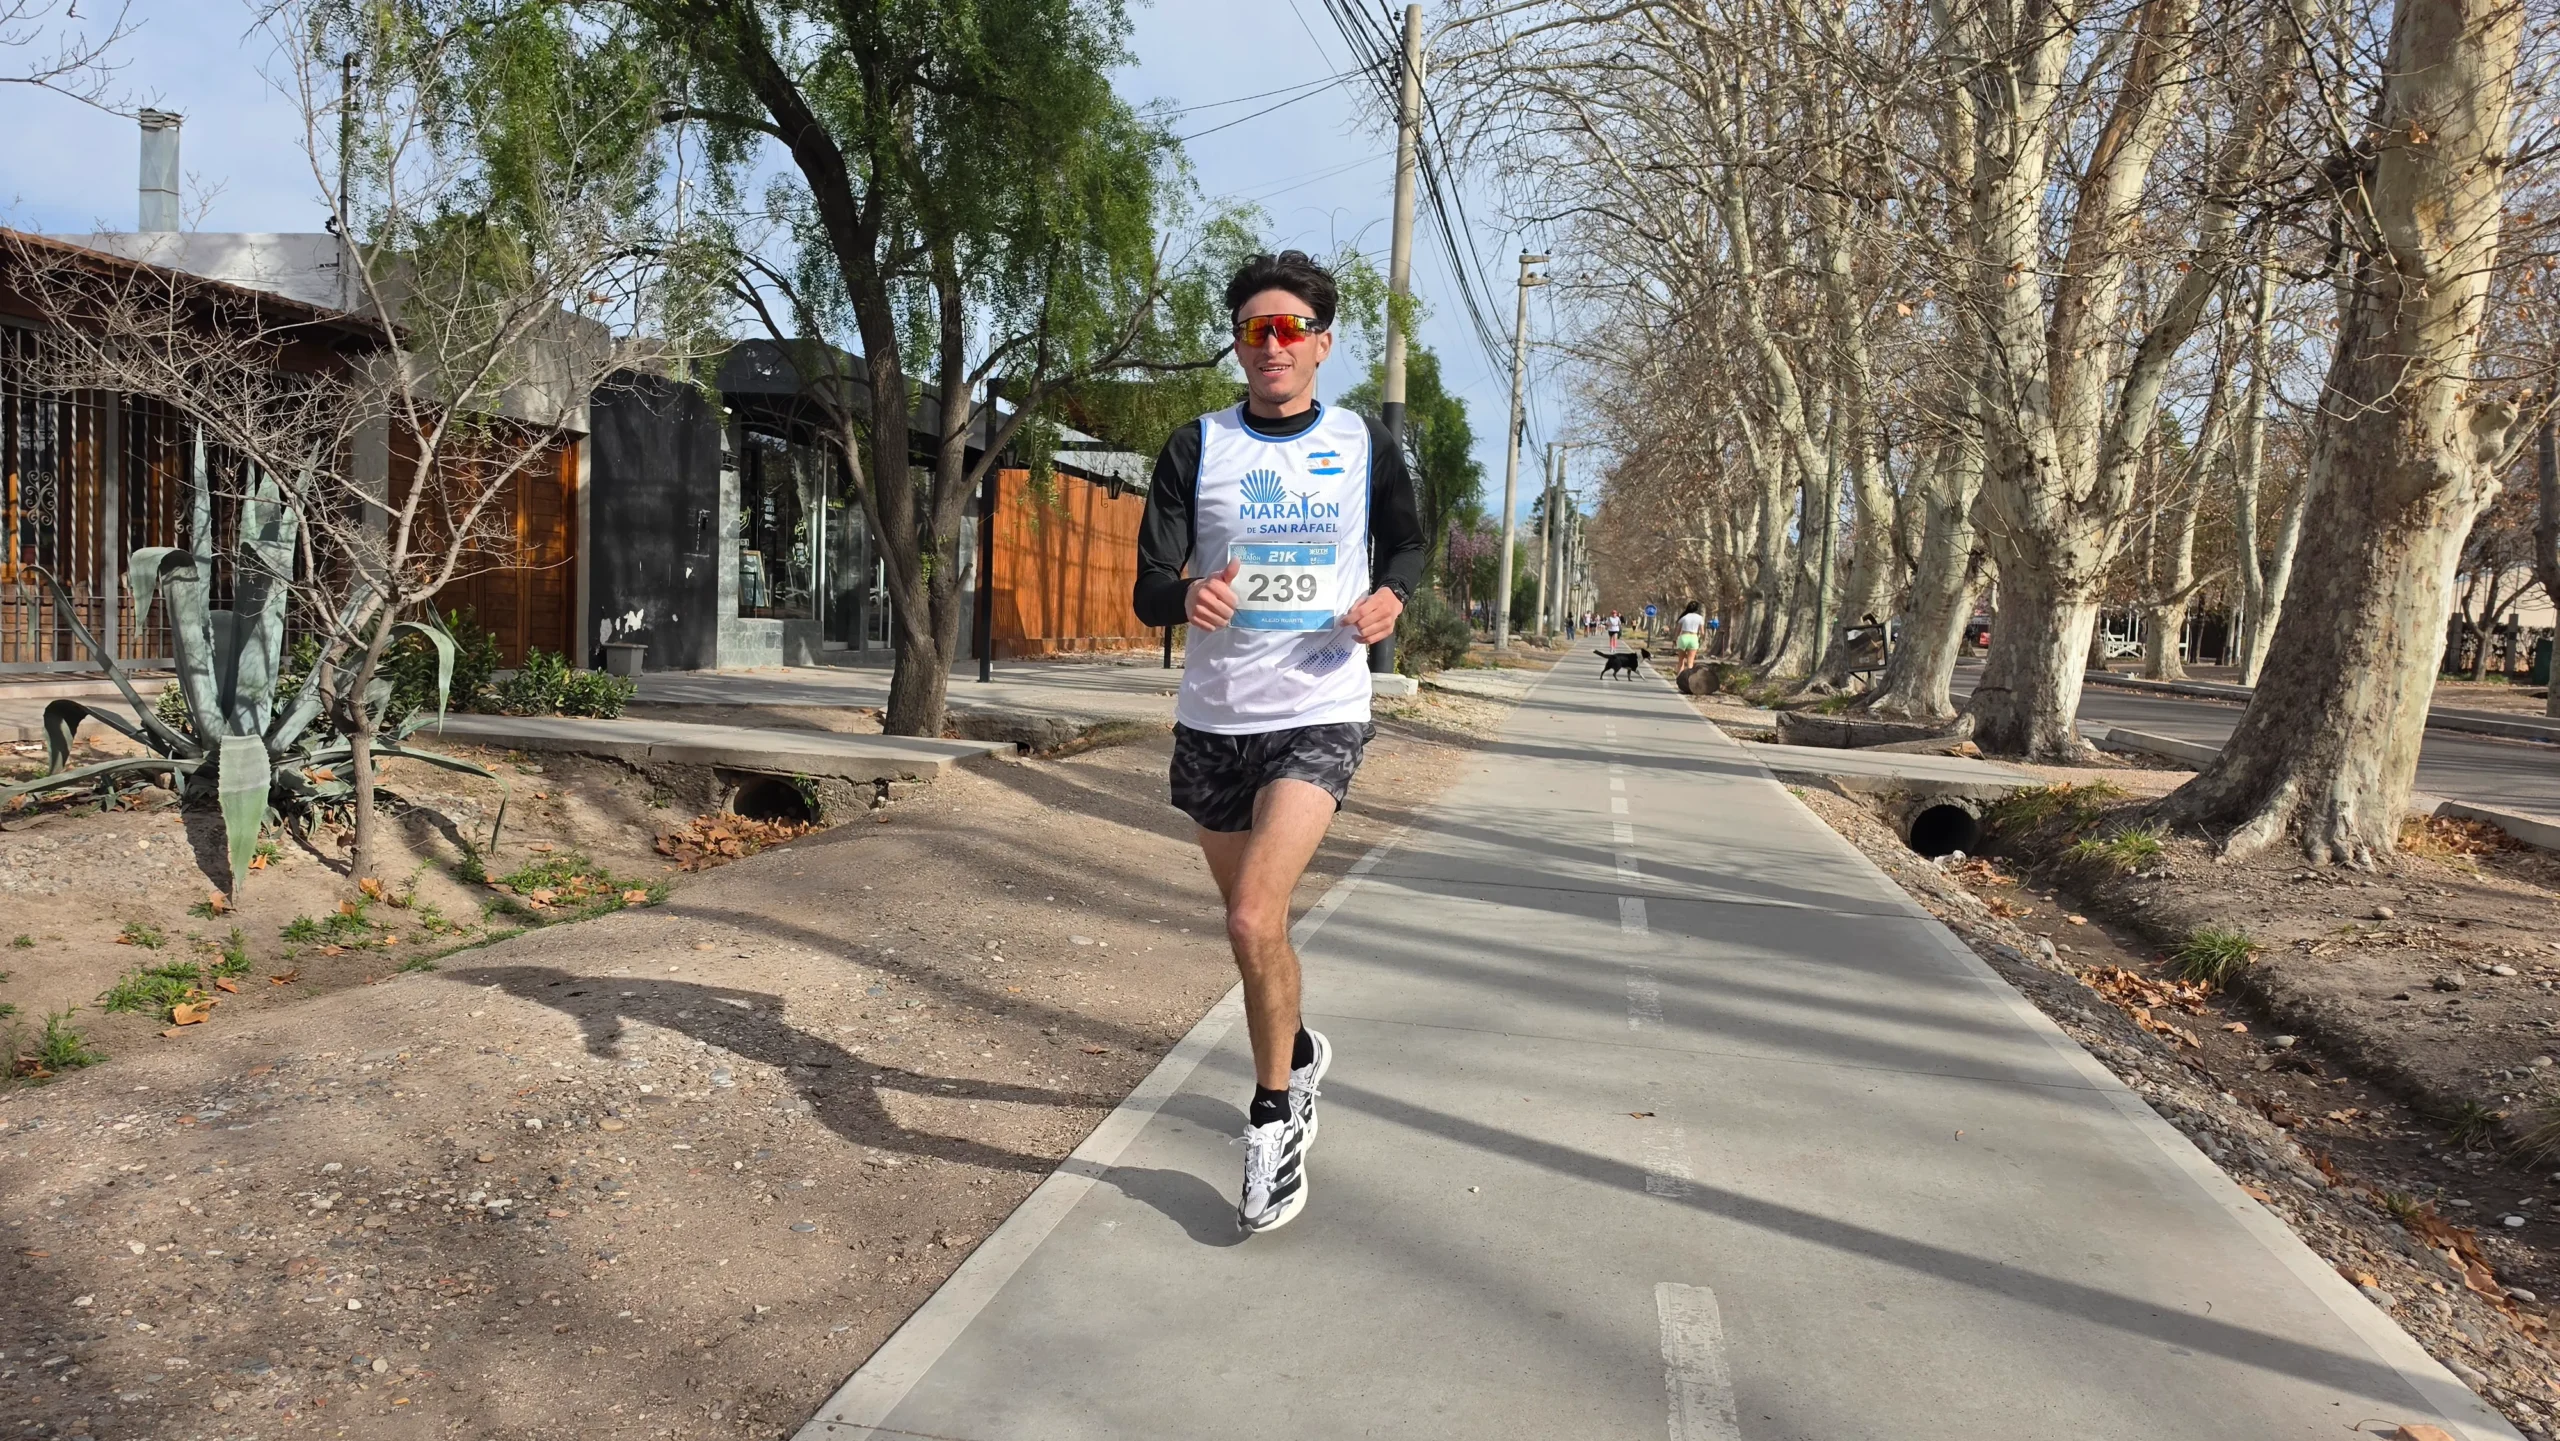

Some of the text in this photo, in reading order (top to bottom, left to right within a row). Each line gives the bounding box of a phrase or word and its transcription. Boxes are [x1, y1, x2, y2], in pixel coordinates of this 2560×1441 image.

[1260, 524, 1287, 534] SAN
[1290, 522, 1338, 534] RAFAEL
[1268, 551, 1298, 563] 21K
[1247, 573, 1317, 603] 239
